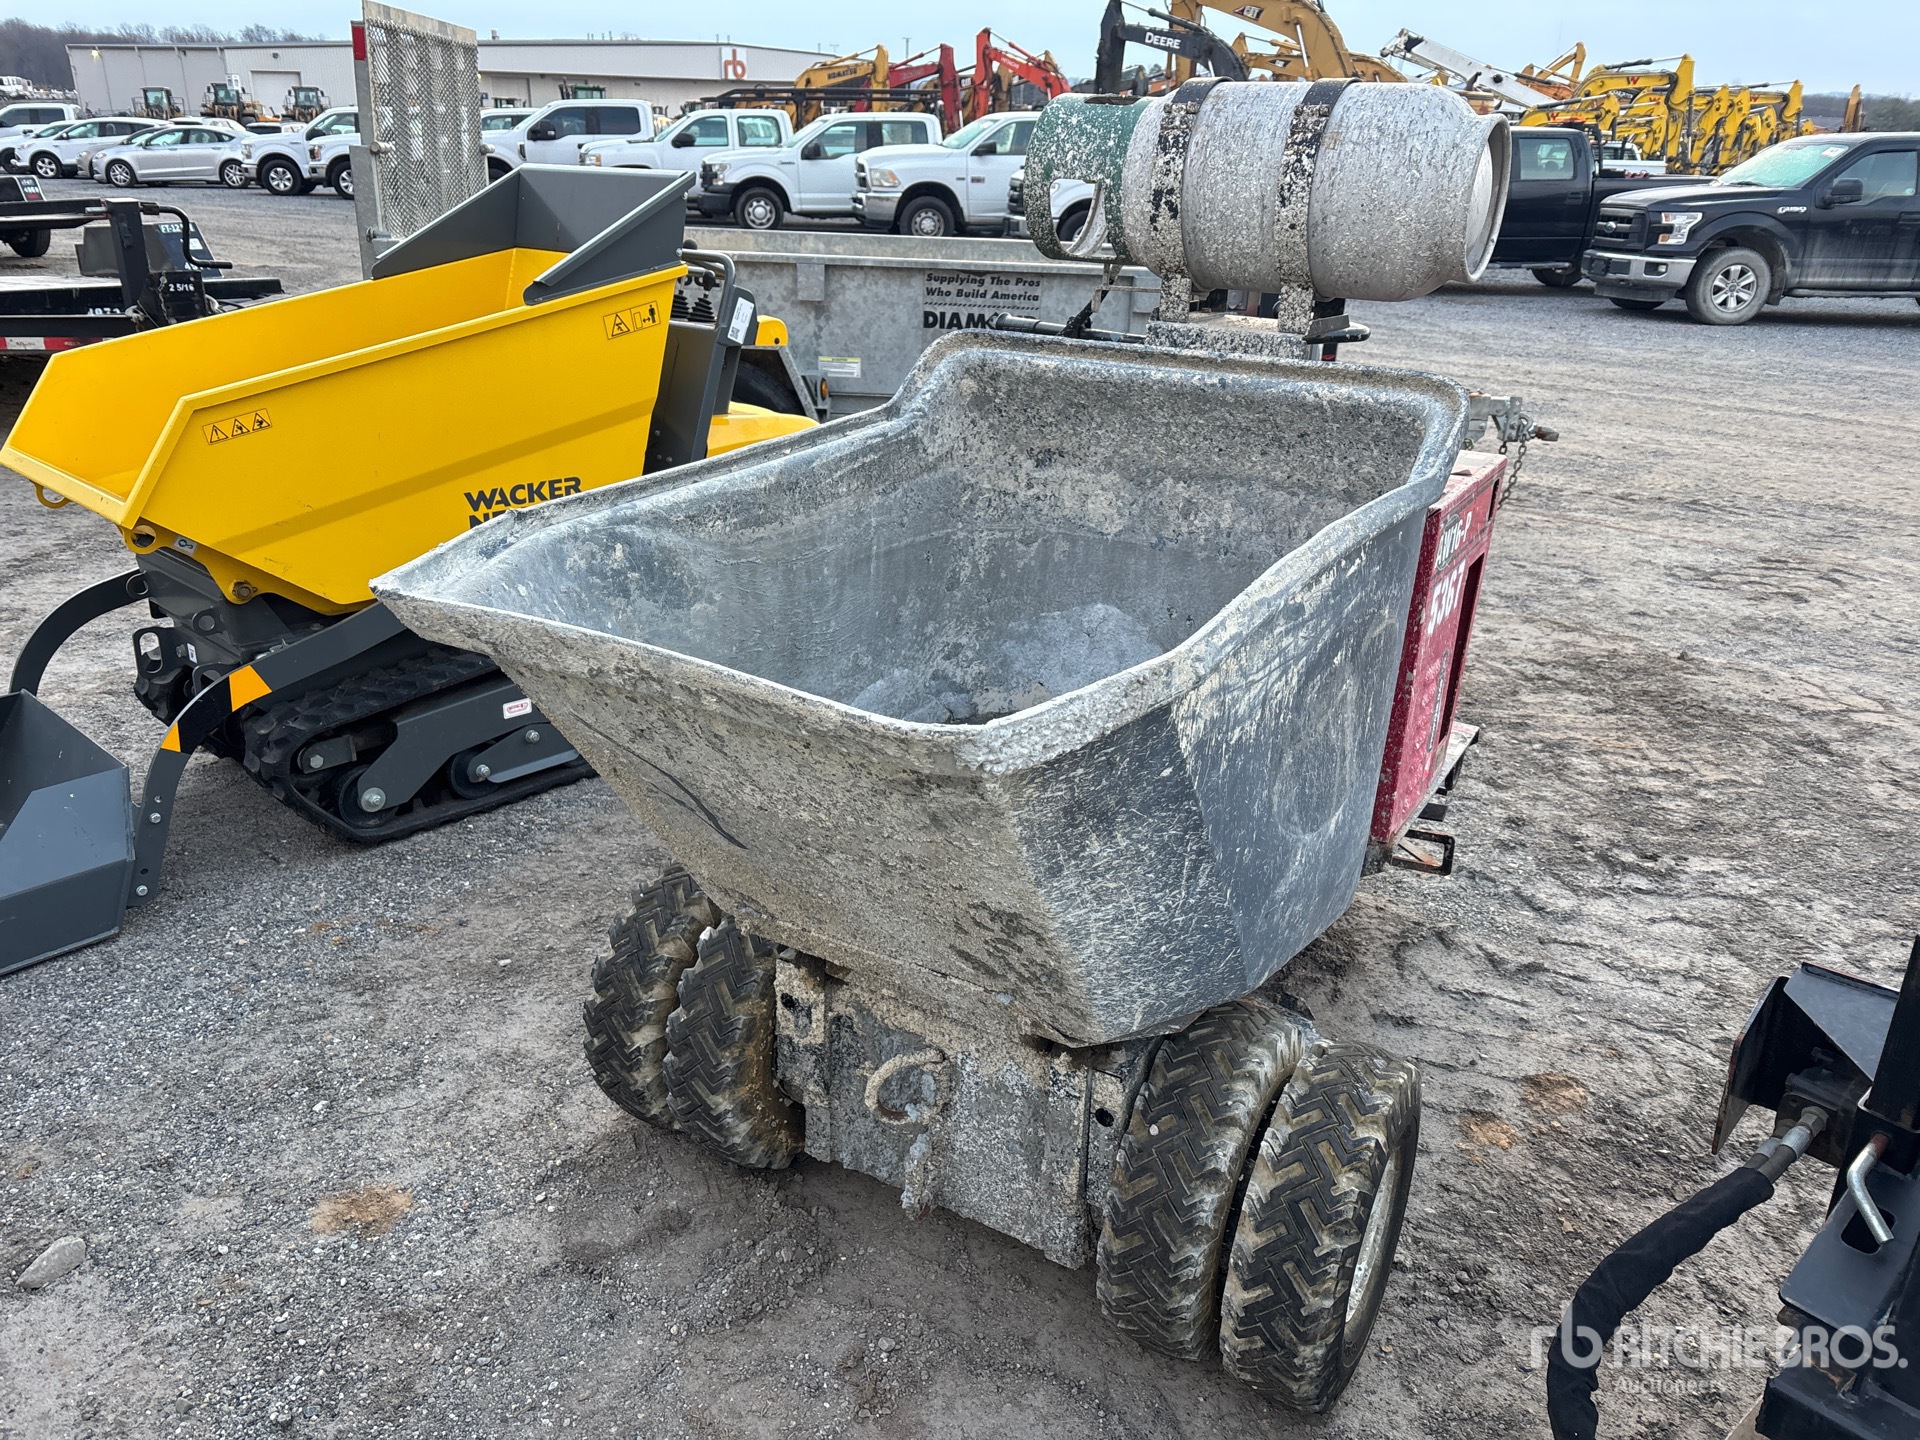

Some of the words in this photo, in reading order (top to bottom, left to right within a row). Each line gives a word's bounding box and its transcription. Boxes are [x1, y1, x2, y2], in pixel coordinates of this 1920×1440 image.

[1144, 31, 1182, 49] DEERE
[926, 273, 986, 287] Supplying
[990, 276, 1011, 286] The
[1015, 277, 1041, 287] Pros
[926, 287, 952, 297] Who
[956, 289, 988, 299] Build
[991, 291, 1039, 302] America
[463, 476, 582, 513] WACKER
[1427, 558, 1467, 637] 5367
